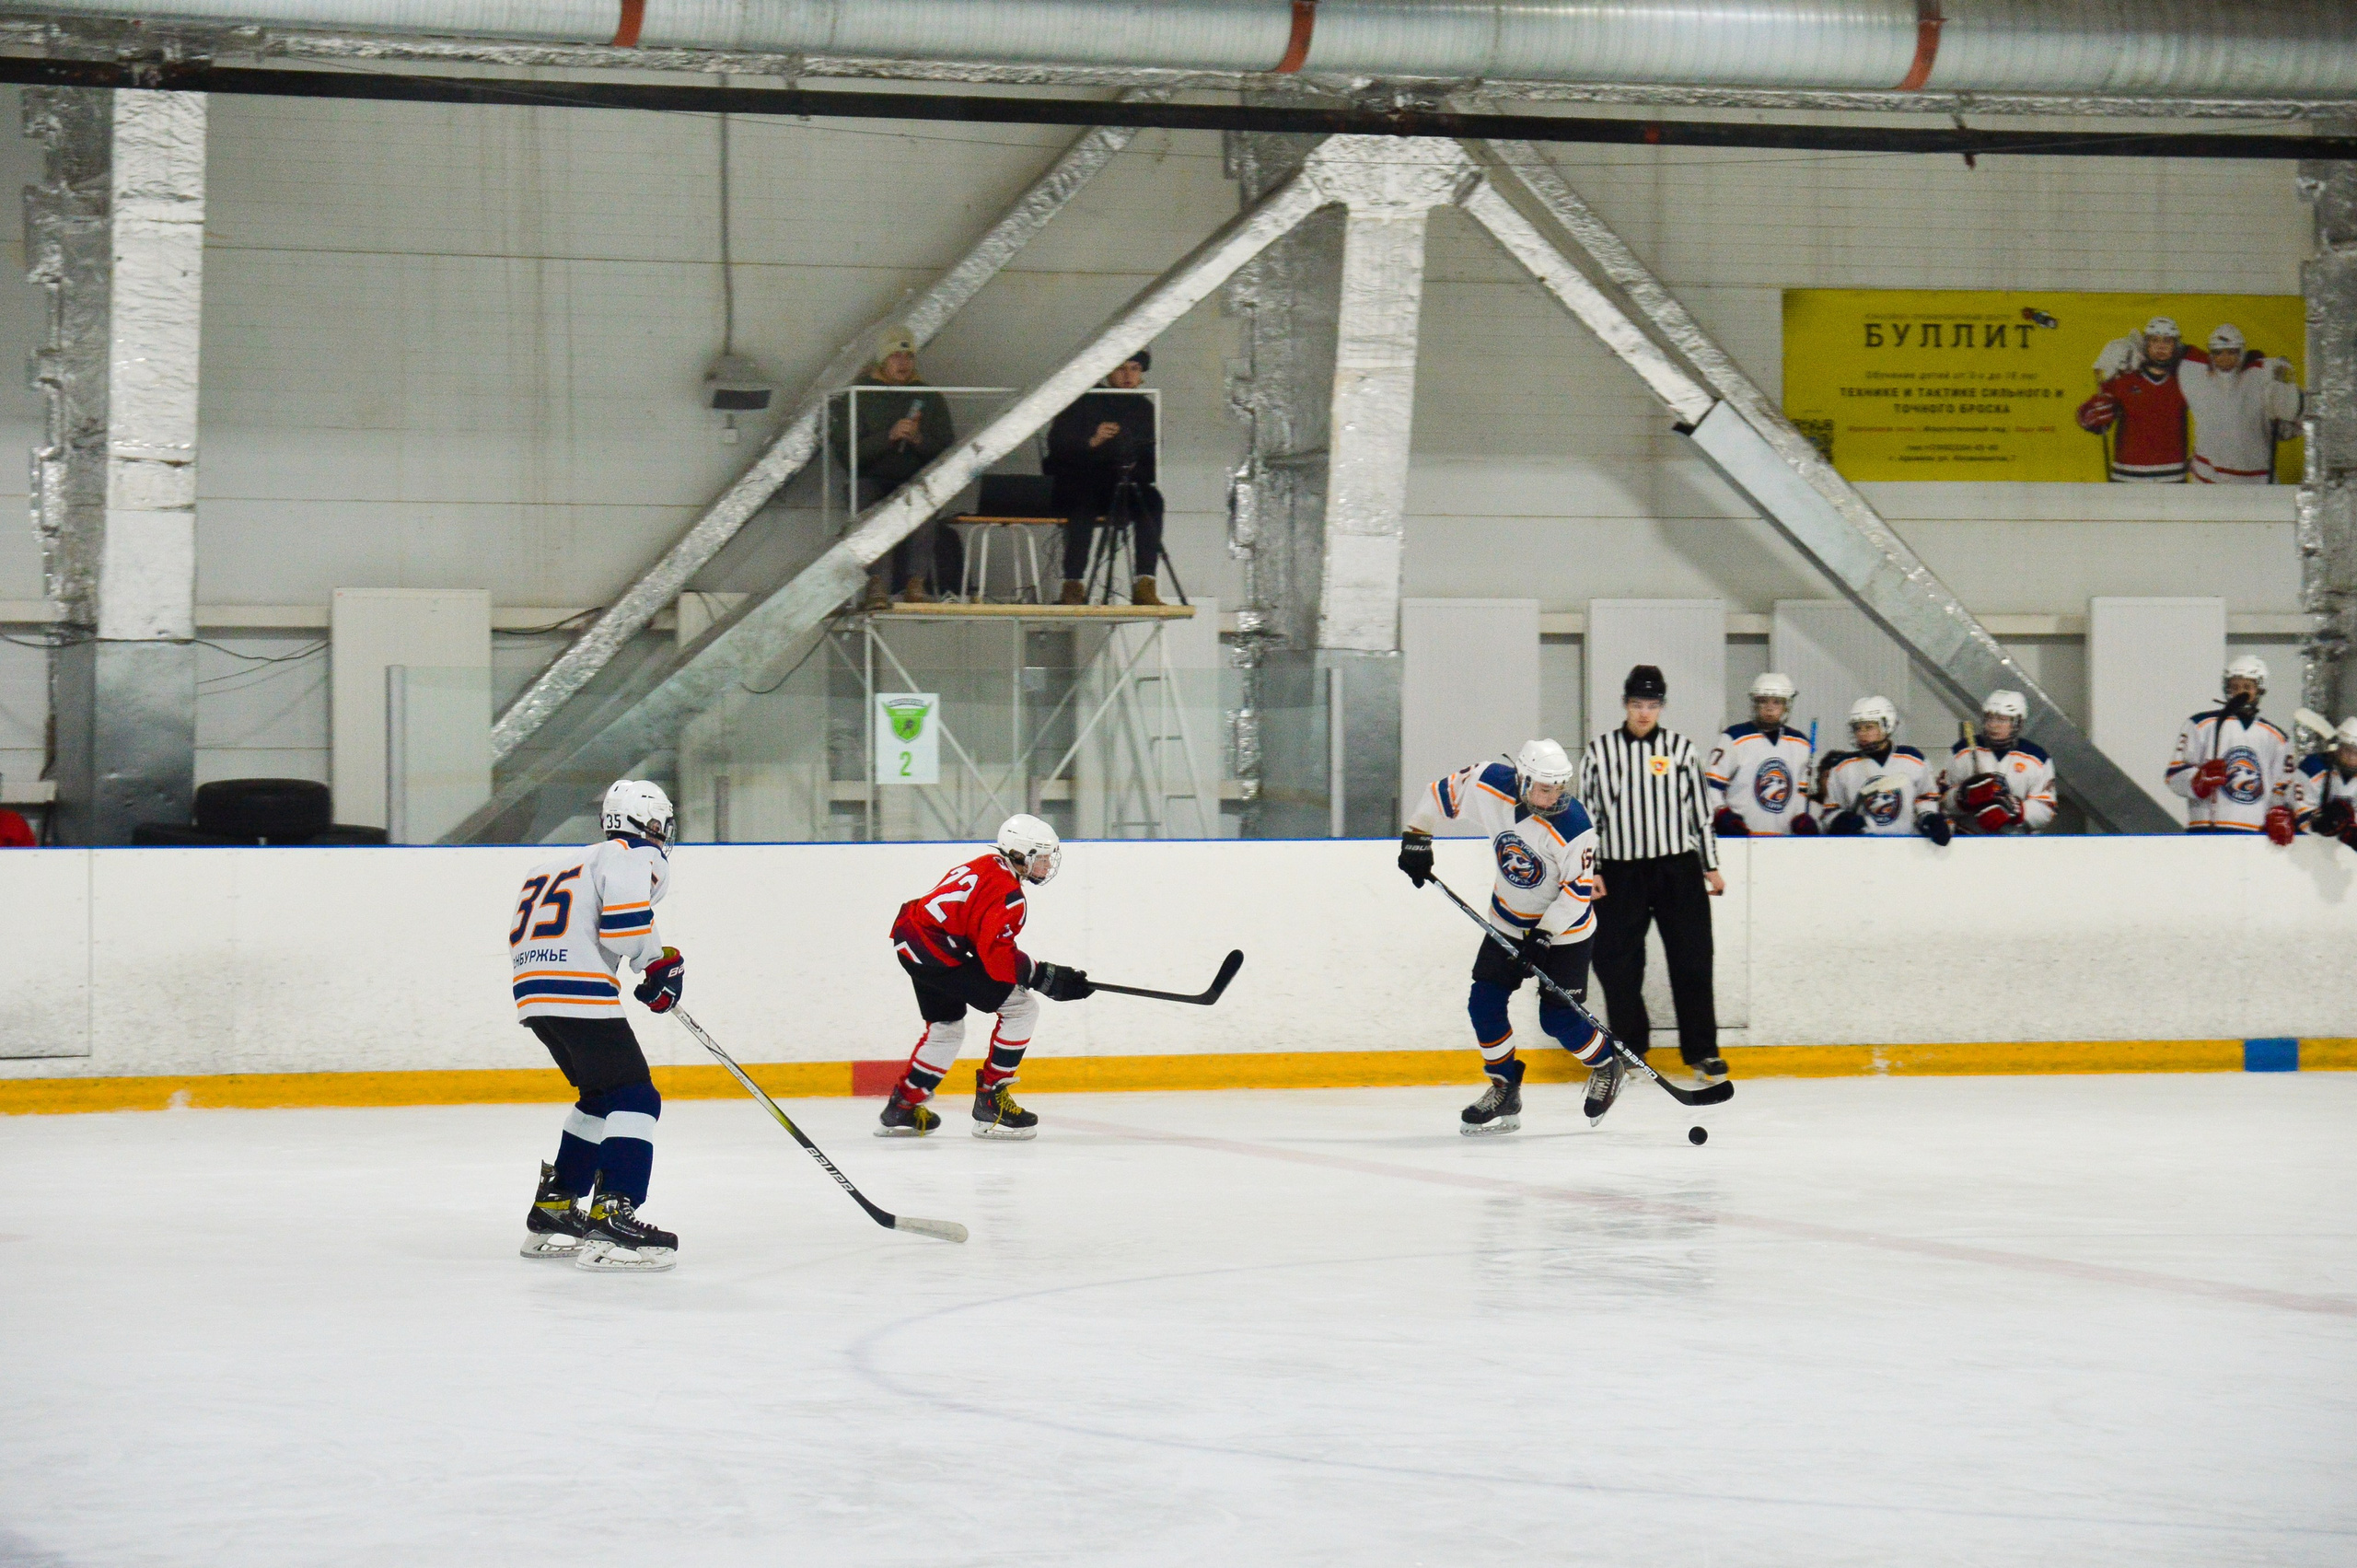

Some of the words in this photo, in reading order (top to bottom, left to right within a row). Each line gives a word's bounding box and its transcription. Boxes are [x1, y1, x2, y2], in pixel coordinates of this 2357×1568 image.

[1864, 323, 2035, 349] БУЛЛИТ
[1840, 388, 1898, 398] ТЕХНИКЕ
[1904, 389, 1912, 398] И
[1918, 388, 1977, 398] ТАКТИКЕ
[1982, 388, 2052, 398] СИЛЬНОГО
[2056, 389, 2064, 398] И
[1894, 403, 1956, 413] ТОЧНОГО
[1959, 403, 2011, 413] БРОСКА
[900, 750, 912, 776] 2
[607, 813, 621, 829] 35
[509, 864, 584, 948] 35
[923, 865, 979, 923] 22
[806, 1146, 855, 1191] BAUER
